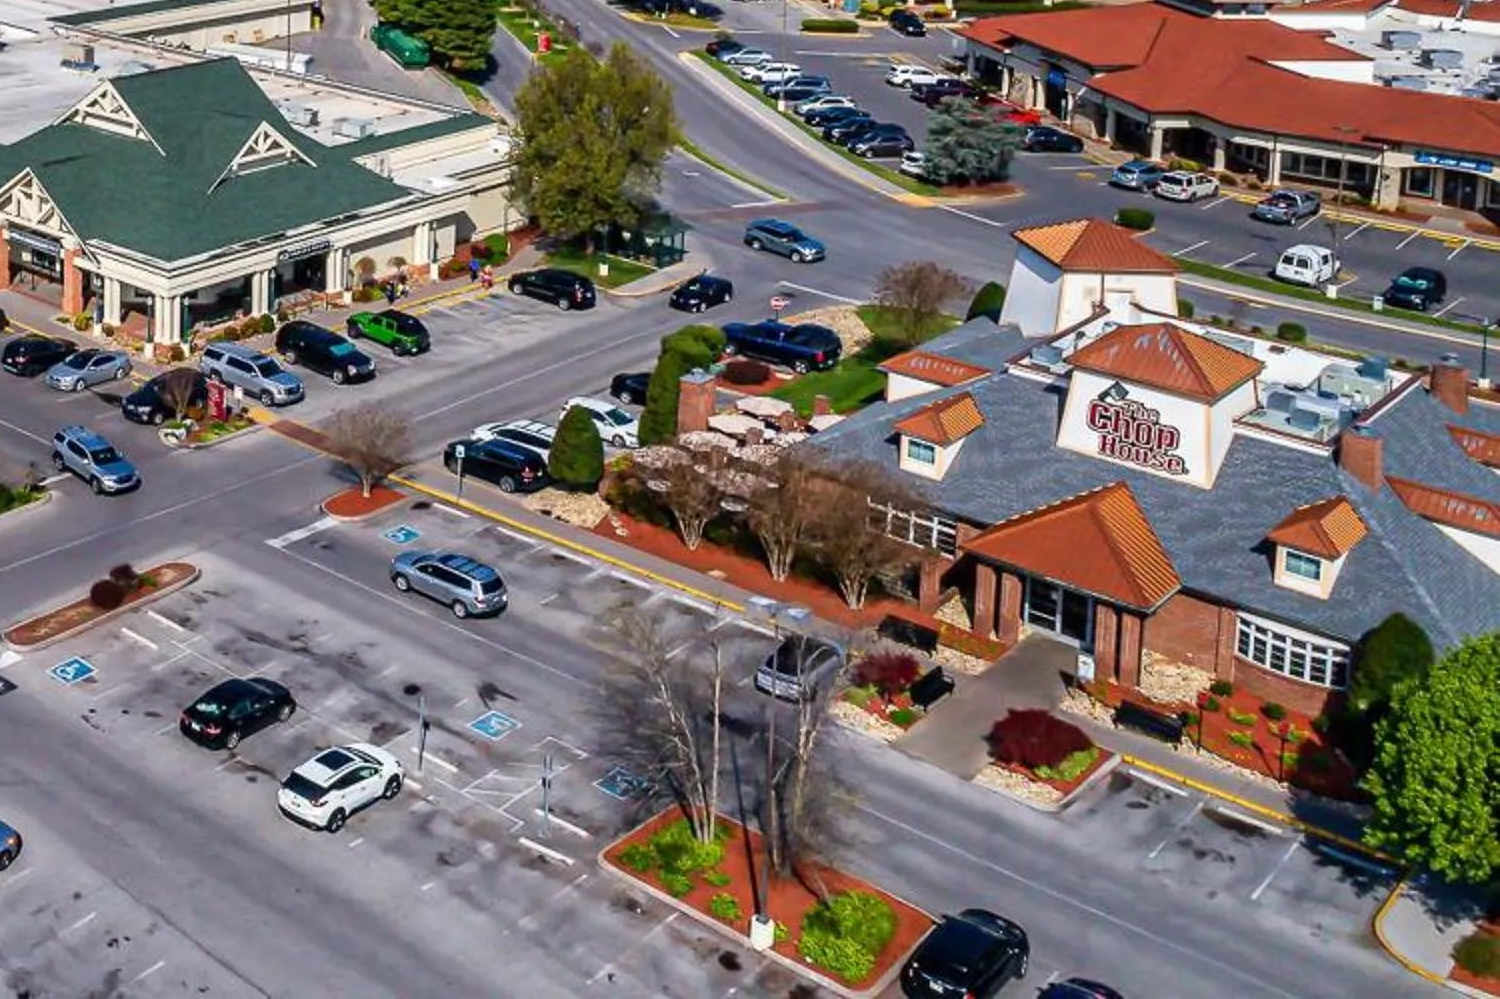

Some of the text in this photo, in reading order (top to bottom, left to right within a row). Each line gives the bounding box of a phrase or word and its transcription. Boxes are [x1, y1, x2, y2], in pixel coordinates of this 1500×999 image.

[1087, 400, 1180, 451] Chop
[1122, 401, 1160, 422] The
[1099, 433, 1186, 475] House
